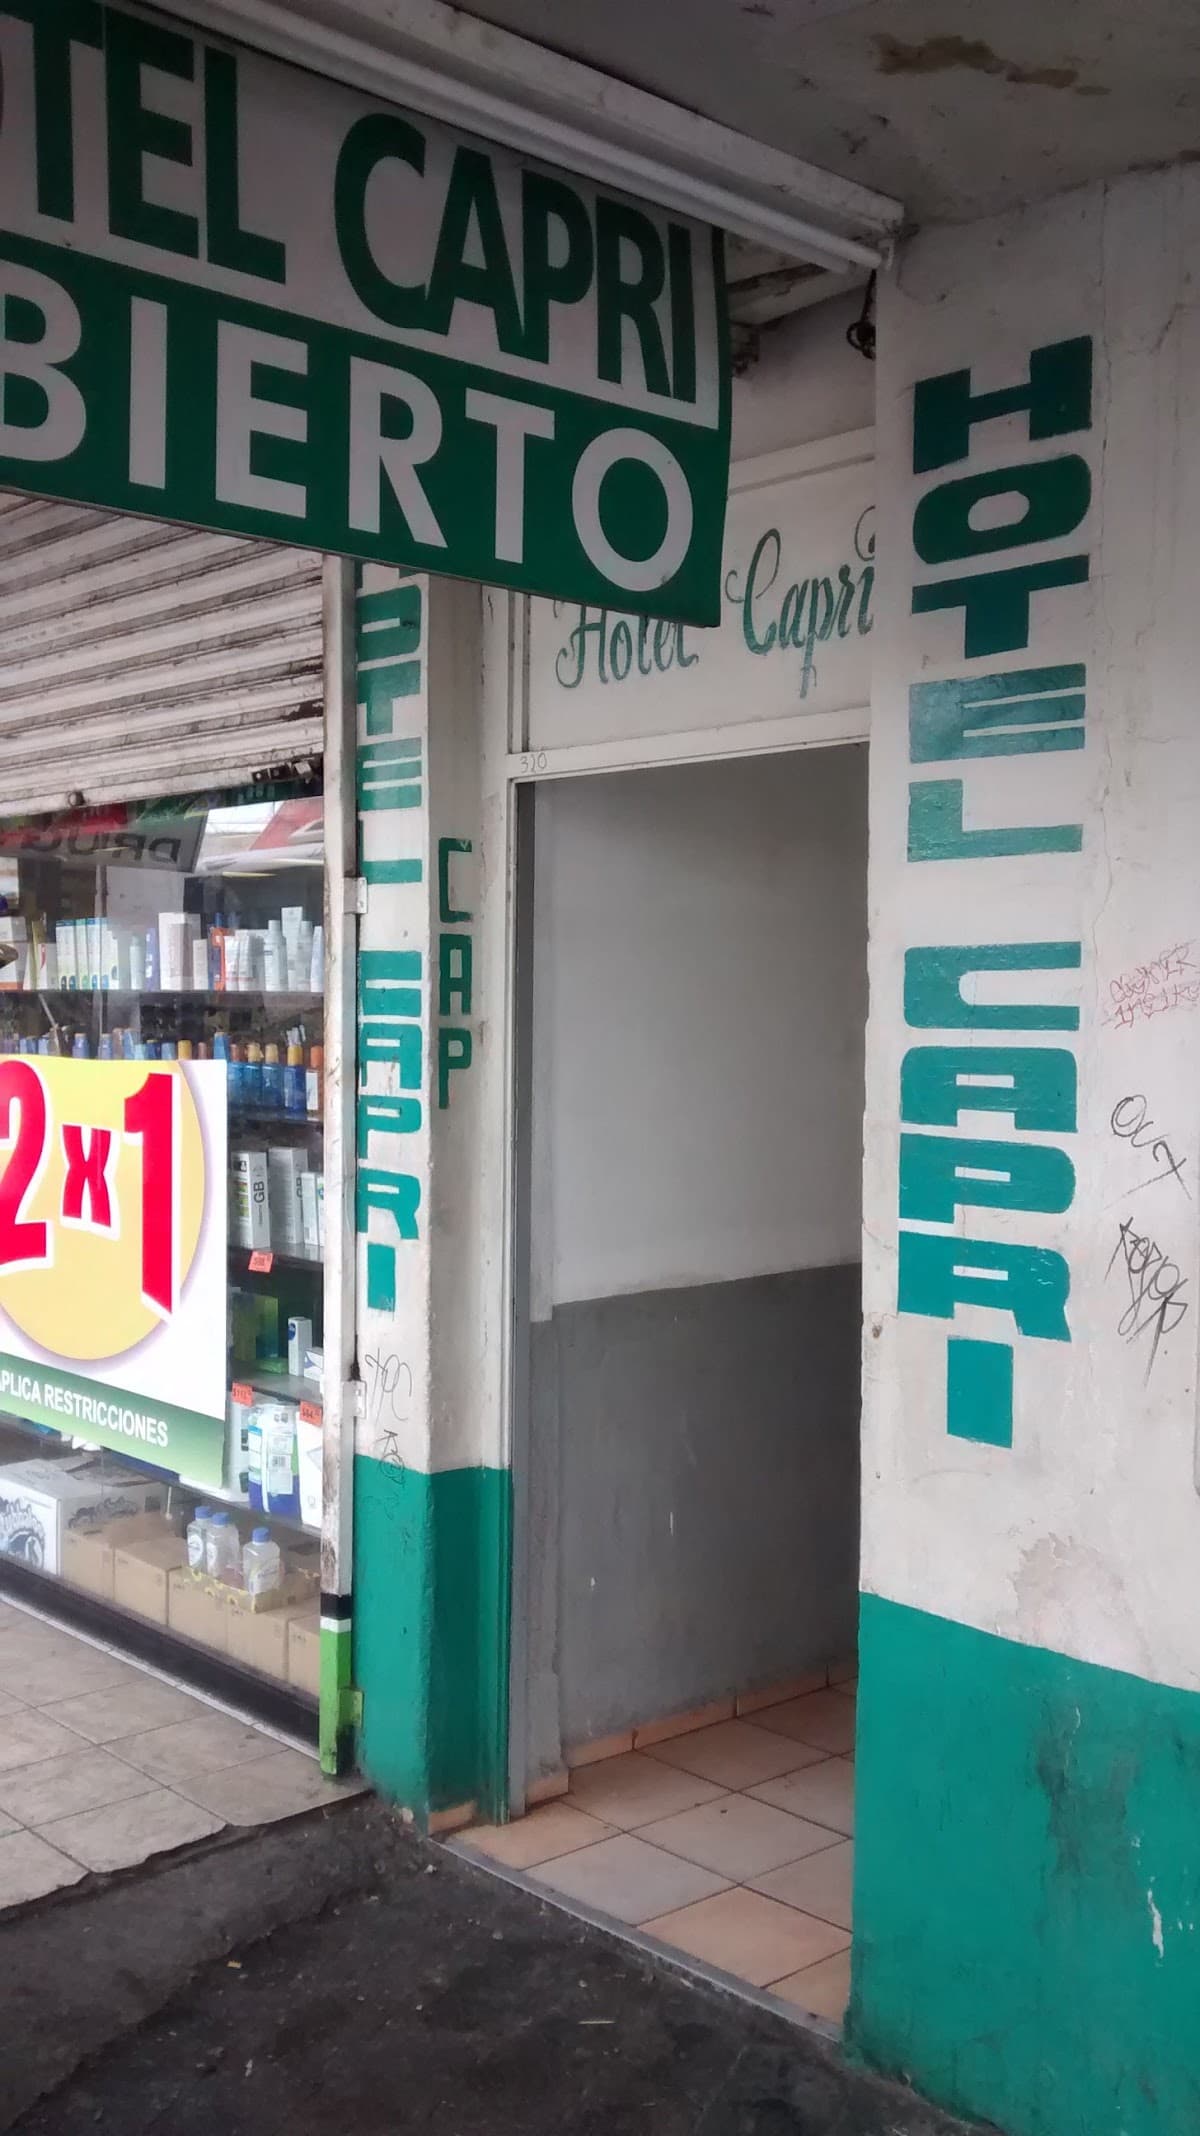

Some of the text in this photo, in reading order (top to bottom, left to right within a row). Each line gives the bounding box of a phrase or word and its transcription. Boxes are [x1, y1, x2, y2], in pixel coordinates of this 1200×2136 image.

[0, 0, 696, 404] TEL CAPRI
[0, 258, 694, 592] BIERTO
[725, 505, 875, 699] Capri
[898, 335, 1093, 1449] HOTEL CAPRI
[0, 1369, 169, 1448] PLICA RESTRICCIONES
